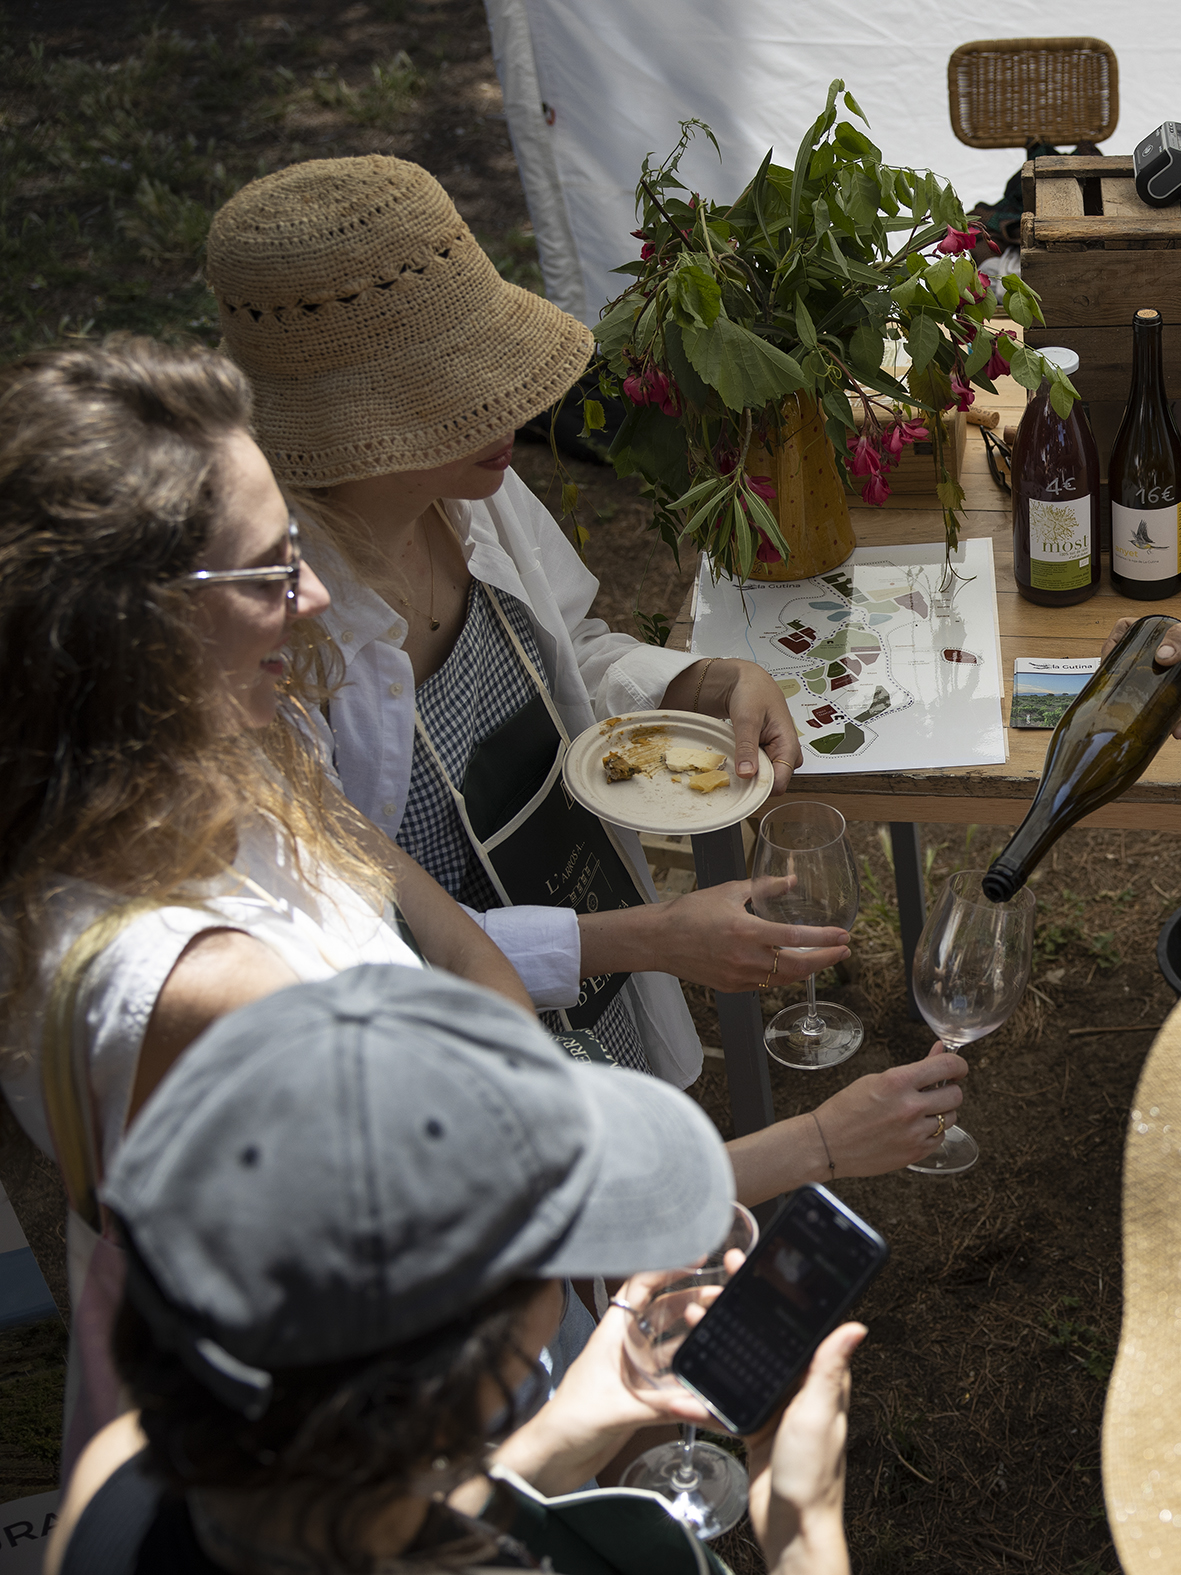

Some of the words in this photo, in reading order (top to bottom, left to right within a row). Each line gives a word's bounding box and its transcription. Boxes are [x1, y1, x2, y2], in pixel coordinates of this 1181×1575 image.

[1045, 477, 1077, 496] 4€
[1135, 485, 1175, 504] 16€
[1042, 534, 1090, 553] most
[1115, 545, 1138, 557] anyet
